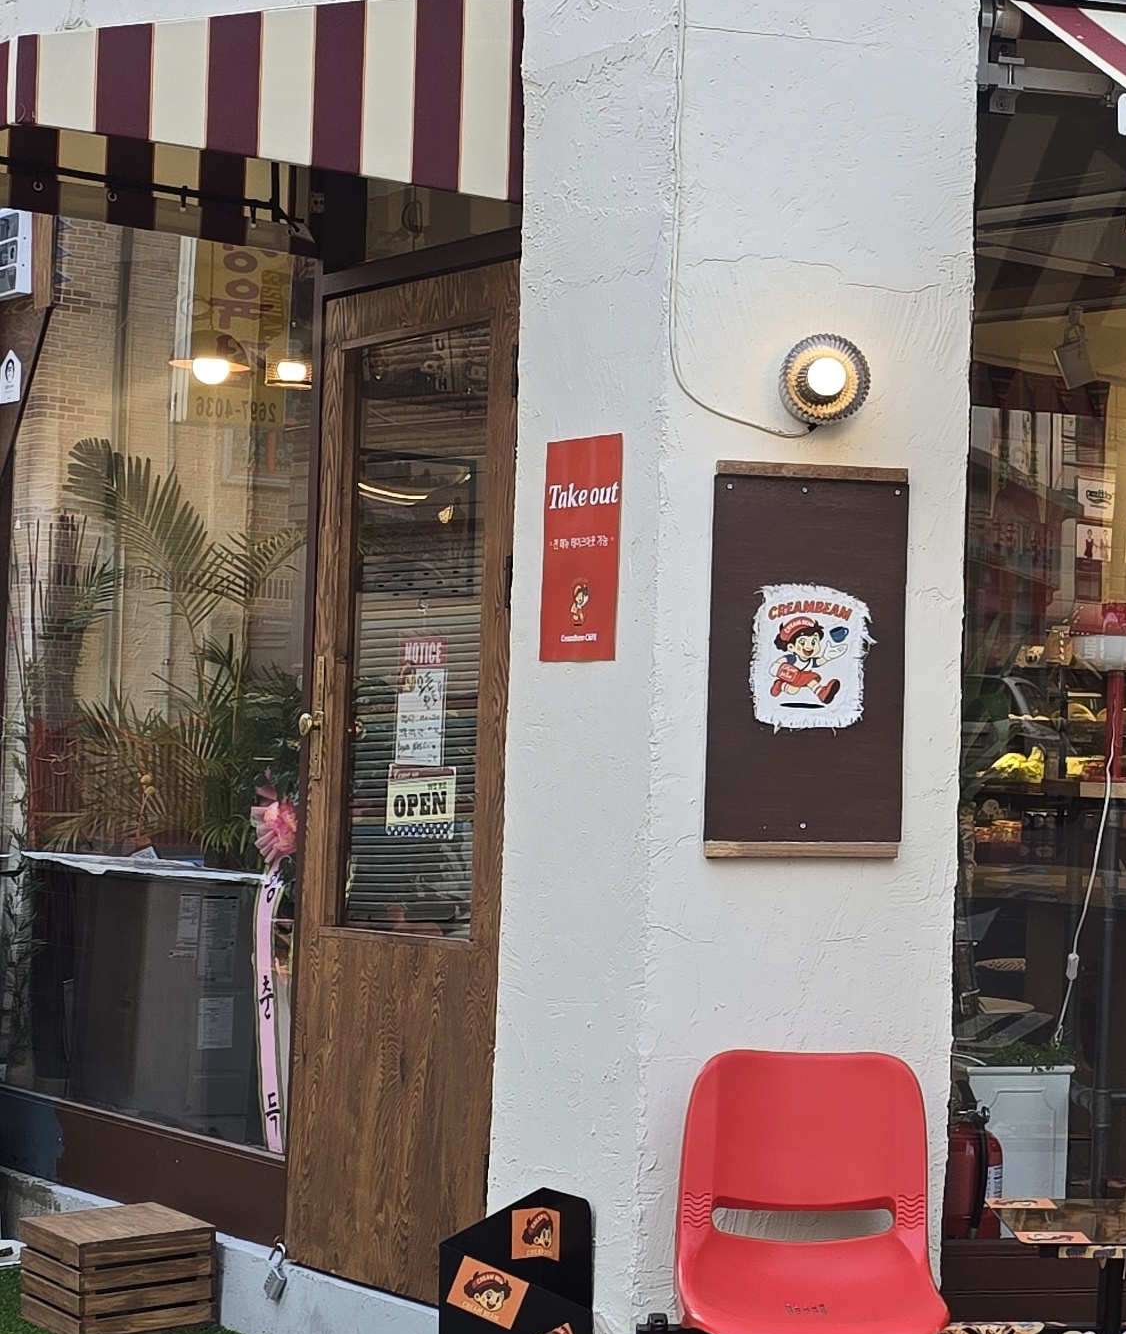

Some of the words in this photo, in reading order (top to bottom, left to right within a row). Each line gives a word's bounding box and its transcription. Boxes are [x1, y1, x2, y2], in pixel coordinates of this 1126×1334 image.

[548, 482, 588, 510] Take
[590, 481, 619, 506] out
[768, 600, 853, 622] CREAMBEAM
[404, 642, 443, 665] NOTICE
[393, 791, 448, 818] OPEN
